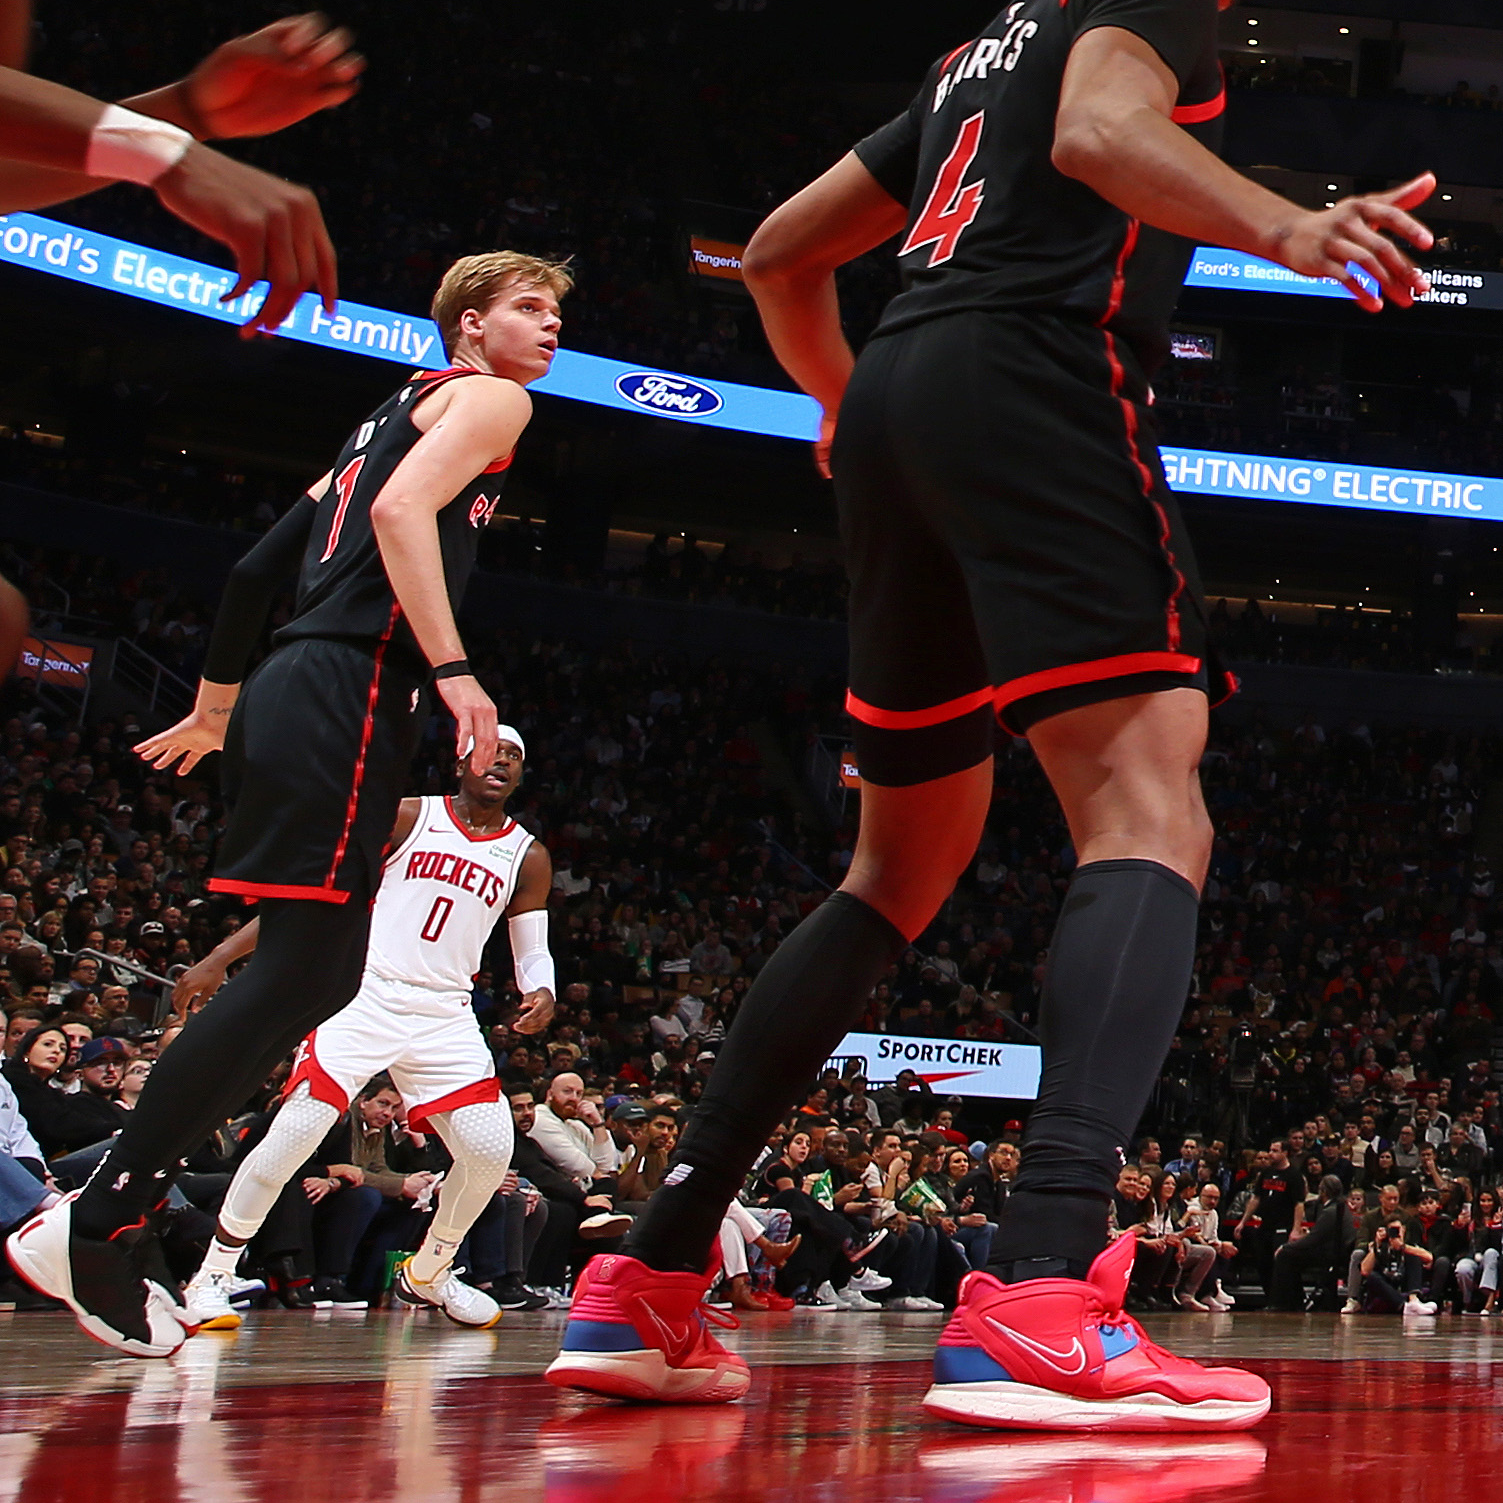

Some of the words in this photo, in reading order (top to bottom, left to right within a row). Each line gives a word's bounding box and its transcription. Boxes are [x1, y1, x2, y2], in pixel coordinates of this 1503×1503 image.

[897, 109, 986, 268] 4
[693, 249, 742, 269] Tangerin
[1194, 260, 1240, 277] Ford's
[0, 216, 100, 275] ord's
[310, 303, 434, 364] Family
[634, 376, 702, 412] Ford
[320, 454, 367, 563] 1
[1333, 471, 1484, 511] ELECTRIC
[404, 851, 505, 909] ROCKETS
[421, 896, 454, 943] 0
[878, 1039, 1003, 1066] SPORTCHEK
